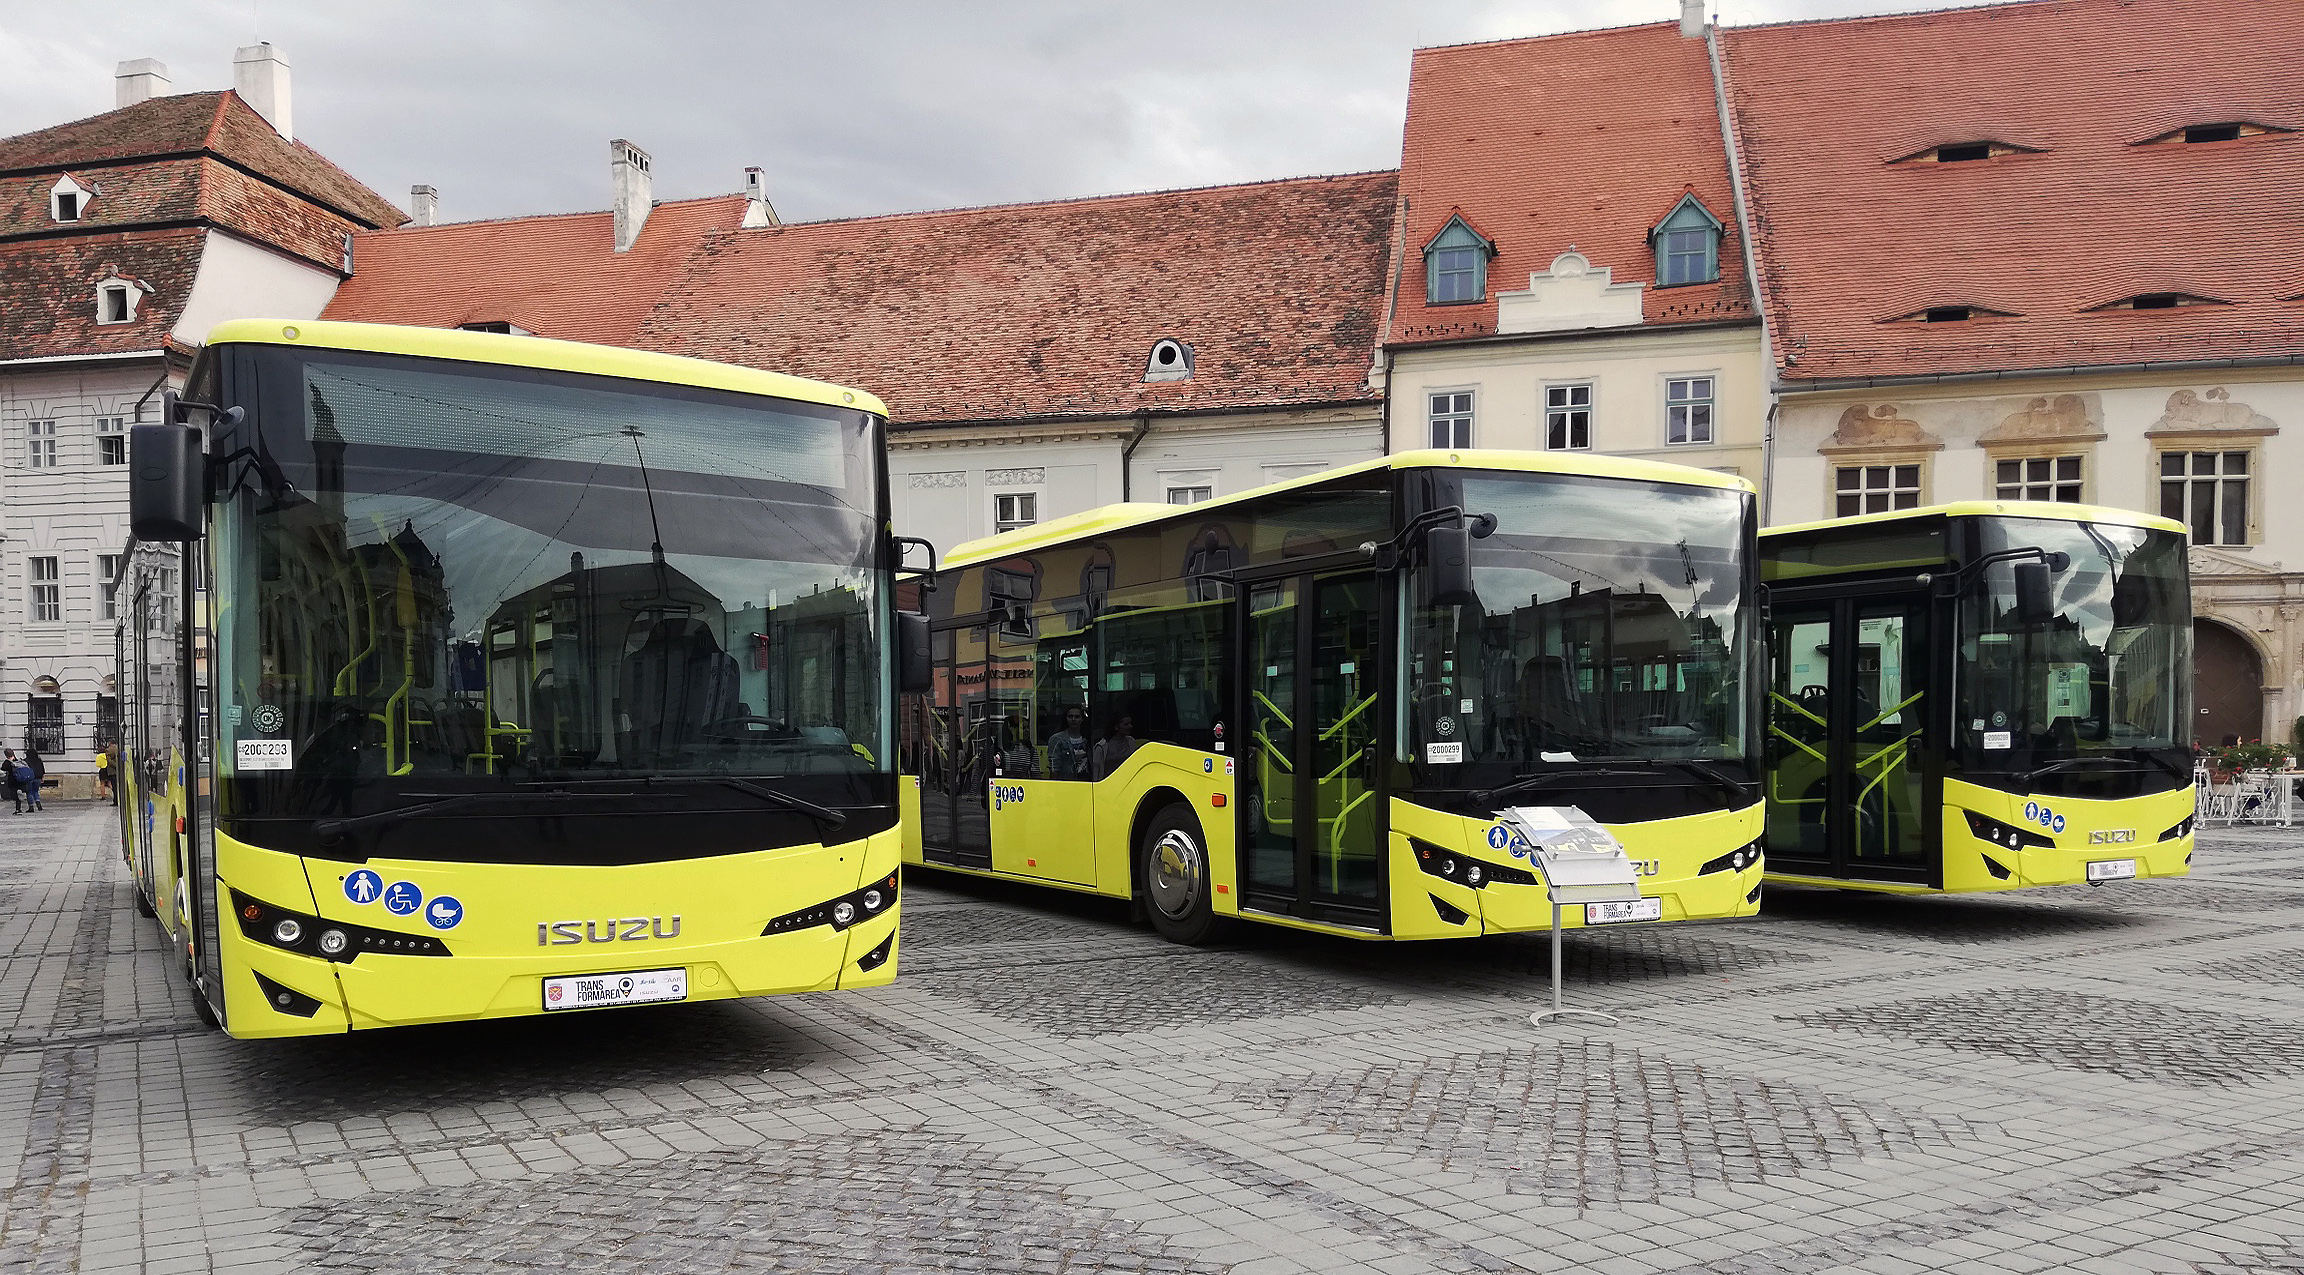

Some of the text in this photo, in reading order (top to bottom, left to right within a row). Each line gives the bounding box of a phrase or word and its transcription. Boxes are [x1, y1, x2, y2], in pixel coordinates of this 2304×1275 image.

[2088, 828, 2136, 845] ISUZU
[538, 914, 681, 947] ISUZU
[575, 980, 604, 992] TRANS
[577, 989, 621, 1002] FORMAREA
